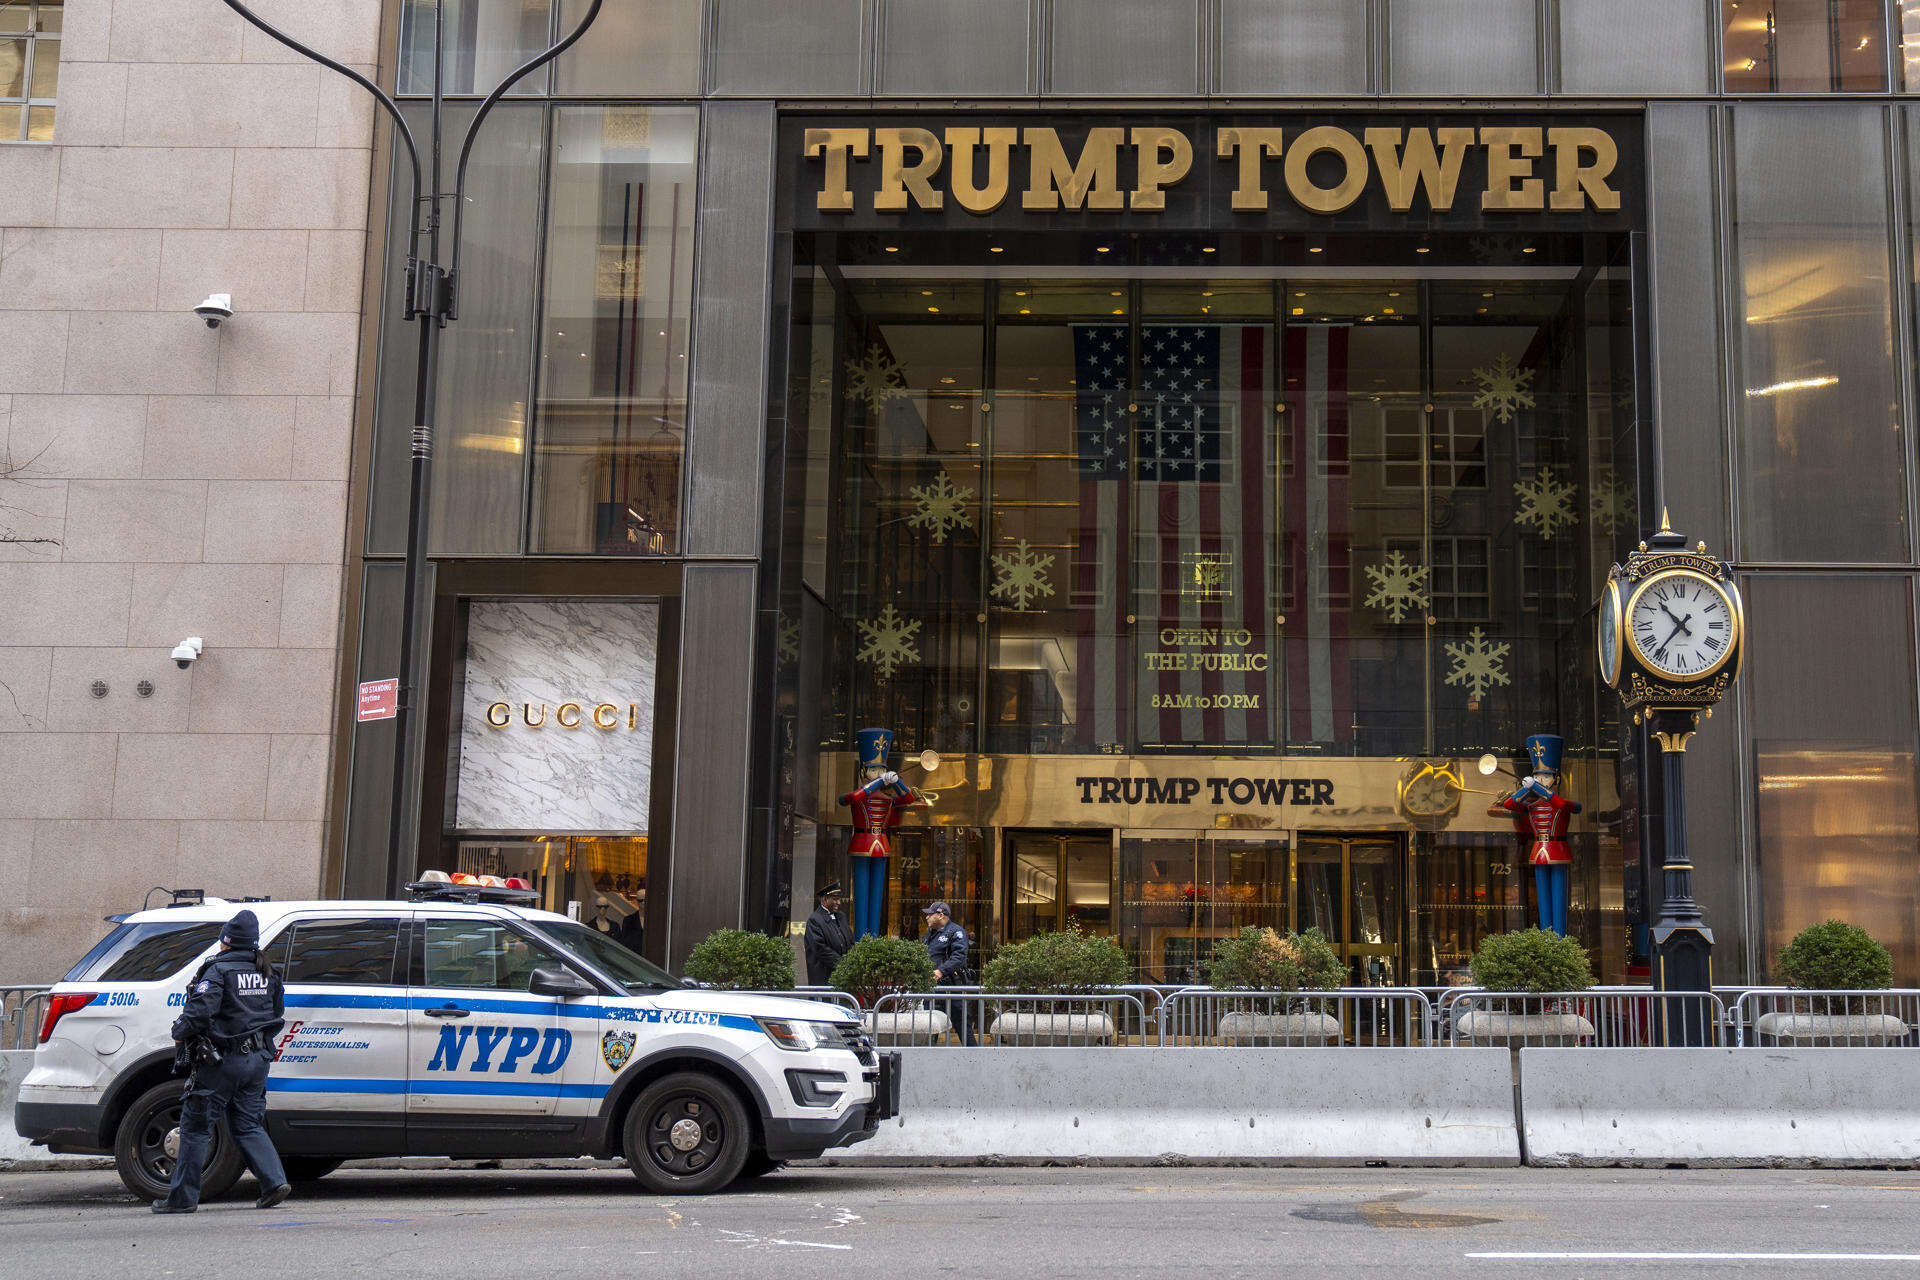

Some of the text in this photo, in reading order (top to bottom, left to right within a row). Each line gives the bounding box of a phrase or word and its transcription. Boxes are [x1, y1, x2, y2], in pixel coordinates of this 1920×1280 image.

[804, 126, 1621, 213] TRUMP TOWER
[1642, 557, 1714, 573] TRUMP TOWER
[1673, 584, 1685, 599] XII
[1160, 628, 1252, 646] OPEN TO
[1144, 653, 1269, 672] THE PUBLIC
[369, 684, 391, 693] STANDING
[1151, 694, 1260, 709] 8 AM to 10 PM
[486, 702, 637, 731] GUCCI
[1076, 777, 1335, 805] TRUMP TOWER
[901, 856, 921, 869] 725
[1490, 863, 1512, 875] 725
[237, 973, 269, 989] NYPD
[109, 992, 136, 1006] 5010
[662, 1009, 719, 1026] POLICE
[289, 1020, 344, 1035] COURTESY
[278, 1035, 370, 1049] PROFESSIONALISM
[427, 1024, 573, 1075] NYPD
